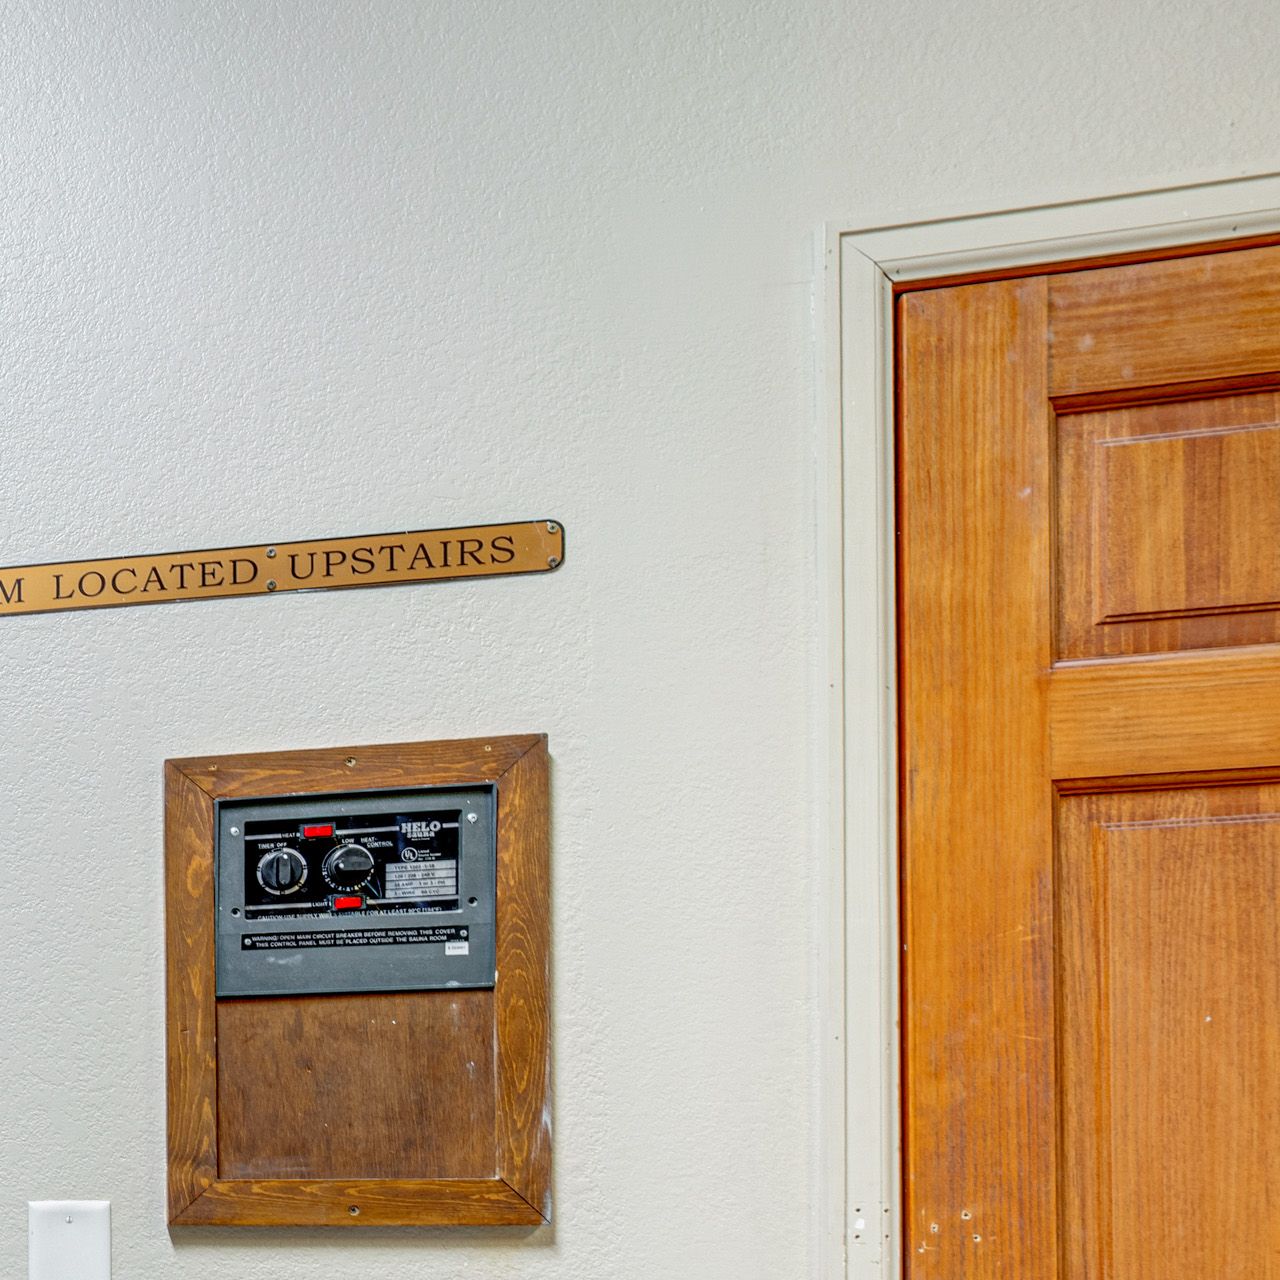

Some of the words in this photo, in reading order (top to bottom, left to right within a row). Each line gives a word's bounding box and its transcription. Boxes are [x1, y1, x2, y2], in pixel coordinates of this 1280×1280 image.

[52, 557, 259, 600] LOCATED
[289, 535, 516, 580] UPSTAIRS
[401, 821, 441, 833] HELO
[366, 841, 393, 849] CONTROL
